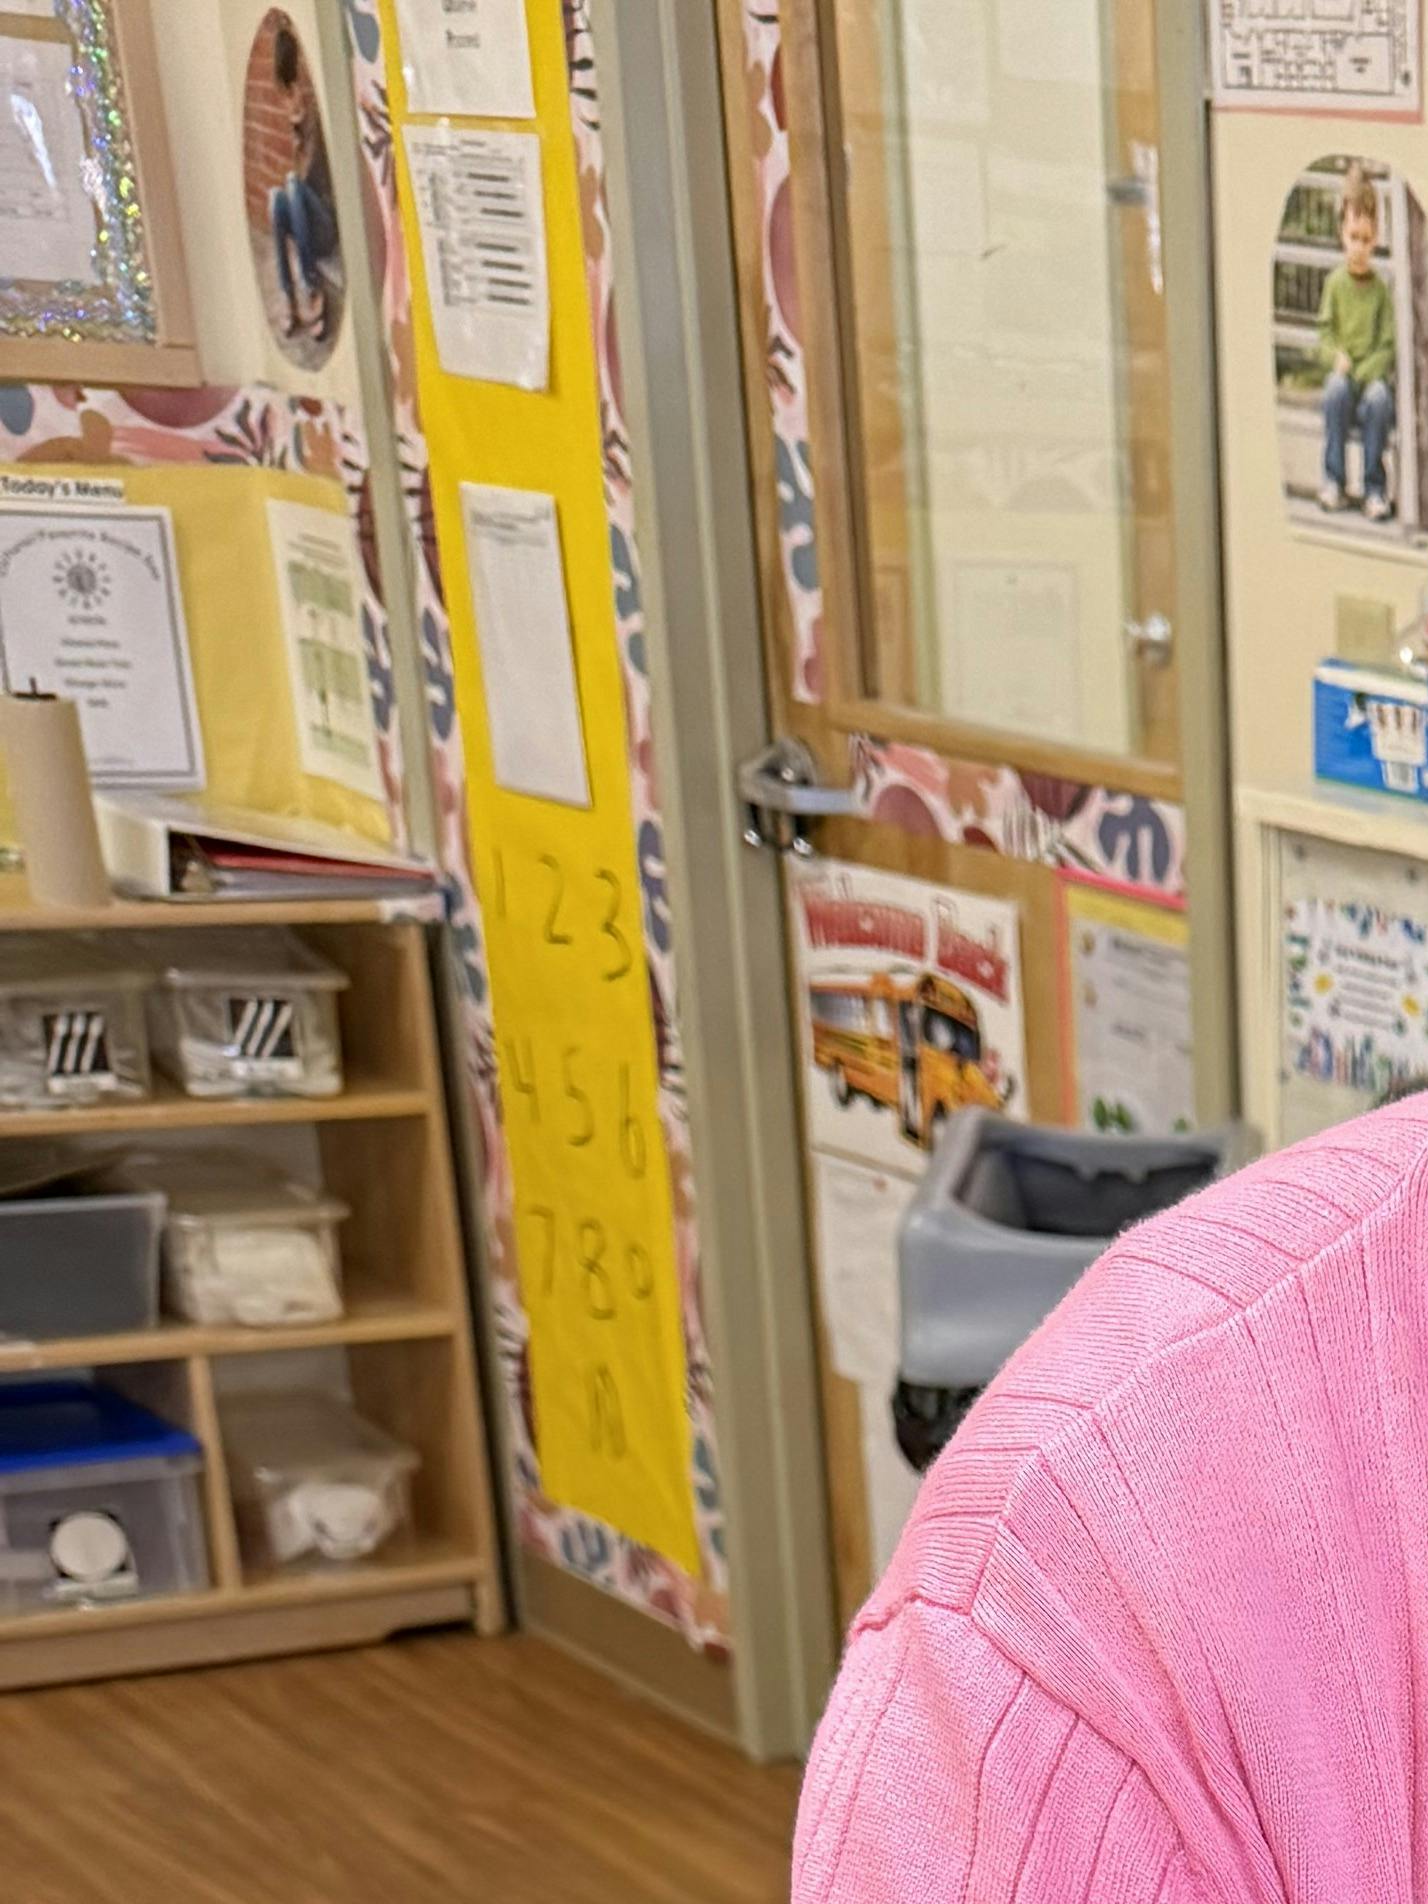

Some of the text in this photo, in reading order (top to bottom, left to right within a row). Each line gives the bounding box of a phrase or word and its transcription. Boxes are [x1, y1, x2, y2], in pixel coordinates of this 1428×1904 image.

[1, 475, 123, 500] Today's Menu
[538, 852, 572, 946] 2
[596, 868, 632, 982] 3
[505, 1034, 648, 1181] 4 5 6
[527, 1204, 555, 1296] 7
[577, 1216, 618, 1321] 8
